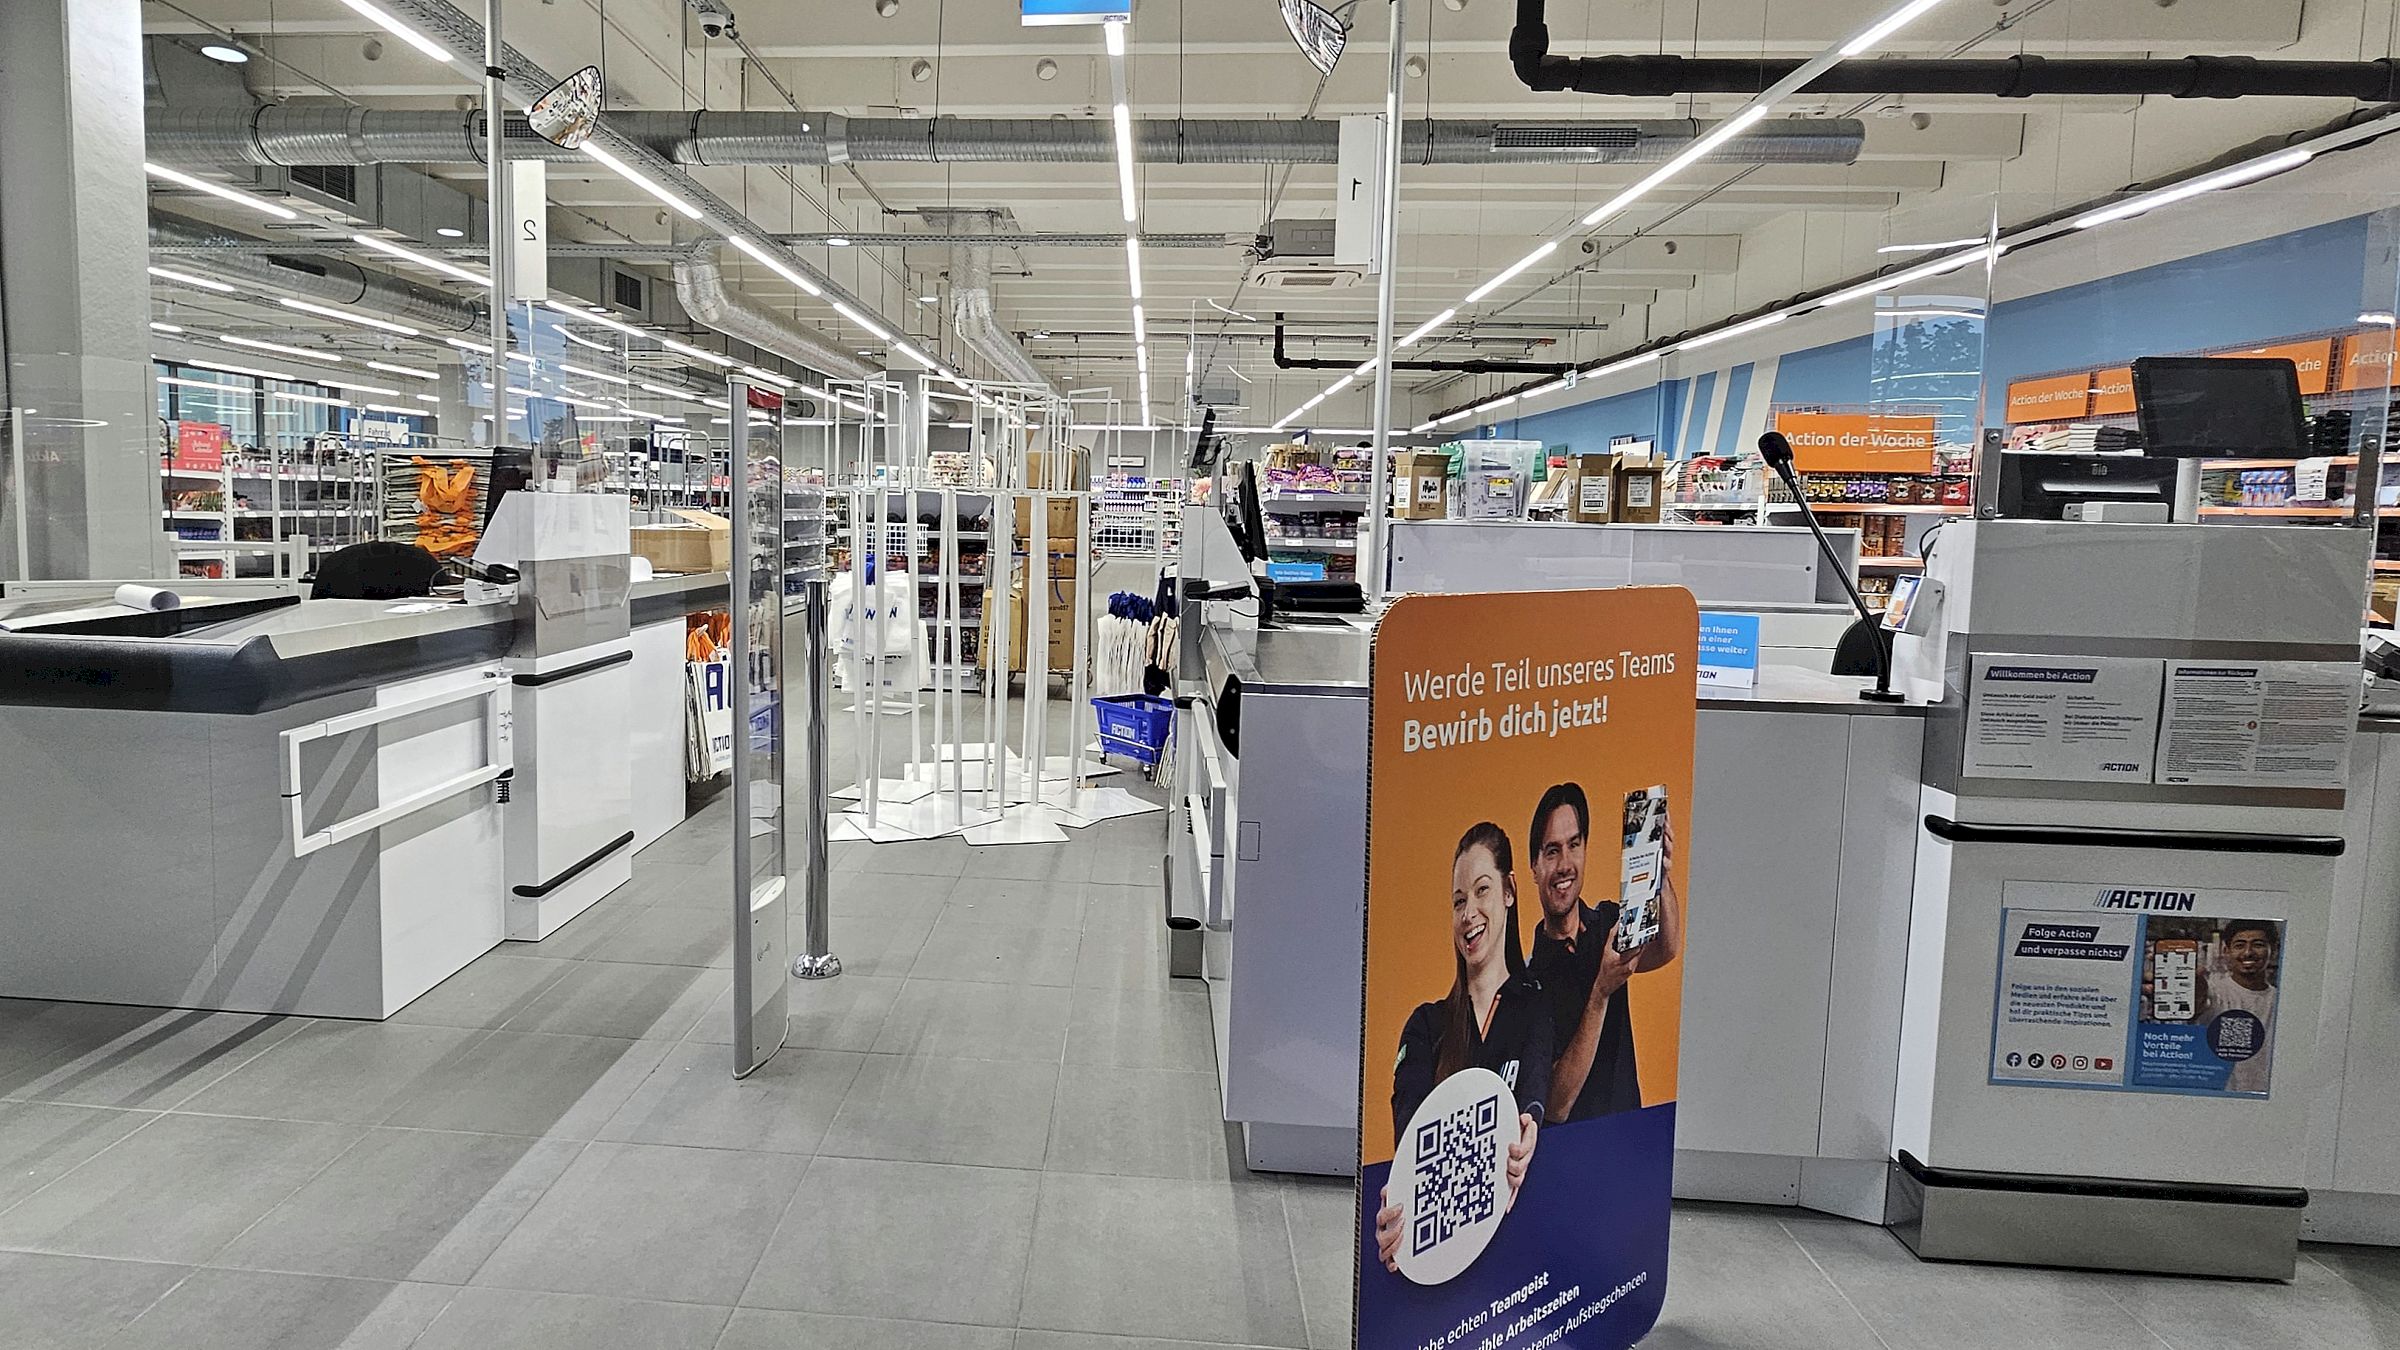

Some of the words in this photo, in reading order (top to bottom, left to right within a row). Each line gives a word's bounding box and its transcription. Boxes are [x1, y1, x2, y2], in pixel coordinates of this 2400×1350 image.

[2296, 358, 2321, 372] che
[2100, 382, 2131, 396] Action
[2011, 394, 2037, 406] Action
[2038, 393, 2053, 403] der
[2055, 389, 2083, 400] Woche
[1785, 431, 1835, 446] Action
[1840, 432, 1867, 446] der
[1871, 433, 1926, 448] Woche
[1713, 626, 1738, 634] Ihnen
[1708, 635, 1732, 644] einer
[1717, 646, 1748, 656] weiter
[1404, 662, 1485, 703] Werde
[1491, 657, 1530, 693] Teil
[1536, 658, 1615, 688] unseres
[1619, 651, 1675, 678] Teams
[1990, 669, 2045, 680] Willkommen
[2045, 671, 2061, 680] bei
[2062, 672, 2091, 681] Action
[705, 663, 731, 712] A
[1404, 708, 1493, 752] Bewirb
[1499, 701, 1546, 739] dich
[1549, 695, 1608, 738] jetzt!
[1111, 722, 1136, 740] ACTION
[711, 734, 732, 753] CTIO
[2101, 762, 2140, 772] ACTION
[2106, 890, 2196, 912] ACTION
[2028, 928, 2057, 938] Folge
[2058, 929, 2092, 939] Action
[2021, 945, 2040, 954] und
[2041, 946, 2087, 957] verpasse
[2088, 947, 2122, 958] nichts!
[2052, 993, 2079, 1001] erfahre
[2057, 1001, 2090, 1010] Produkte
[2033, 1009, 2071, 1018] praktische
[2144, 1032, 2169, 1041] Noch
[2170, 1034, 2195, 1042] mehr
[2143, 1041, 2182, 1050] Vorteile
[2143, 1050, 2158, 1058] bei
[2159, 1051, 2194, 1060] Action!
[1447, 1310, 1488, 1344] echten
[1490, 1271, 1549, 1318] Teamgeist
[1565, 1271, 1647, 1335] Aufstiegschancen
[1506, 1284, 1580, 1342] Arbeitszeiten
